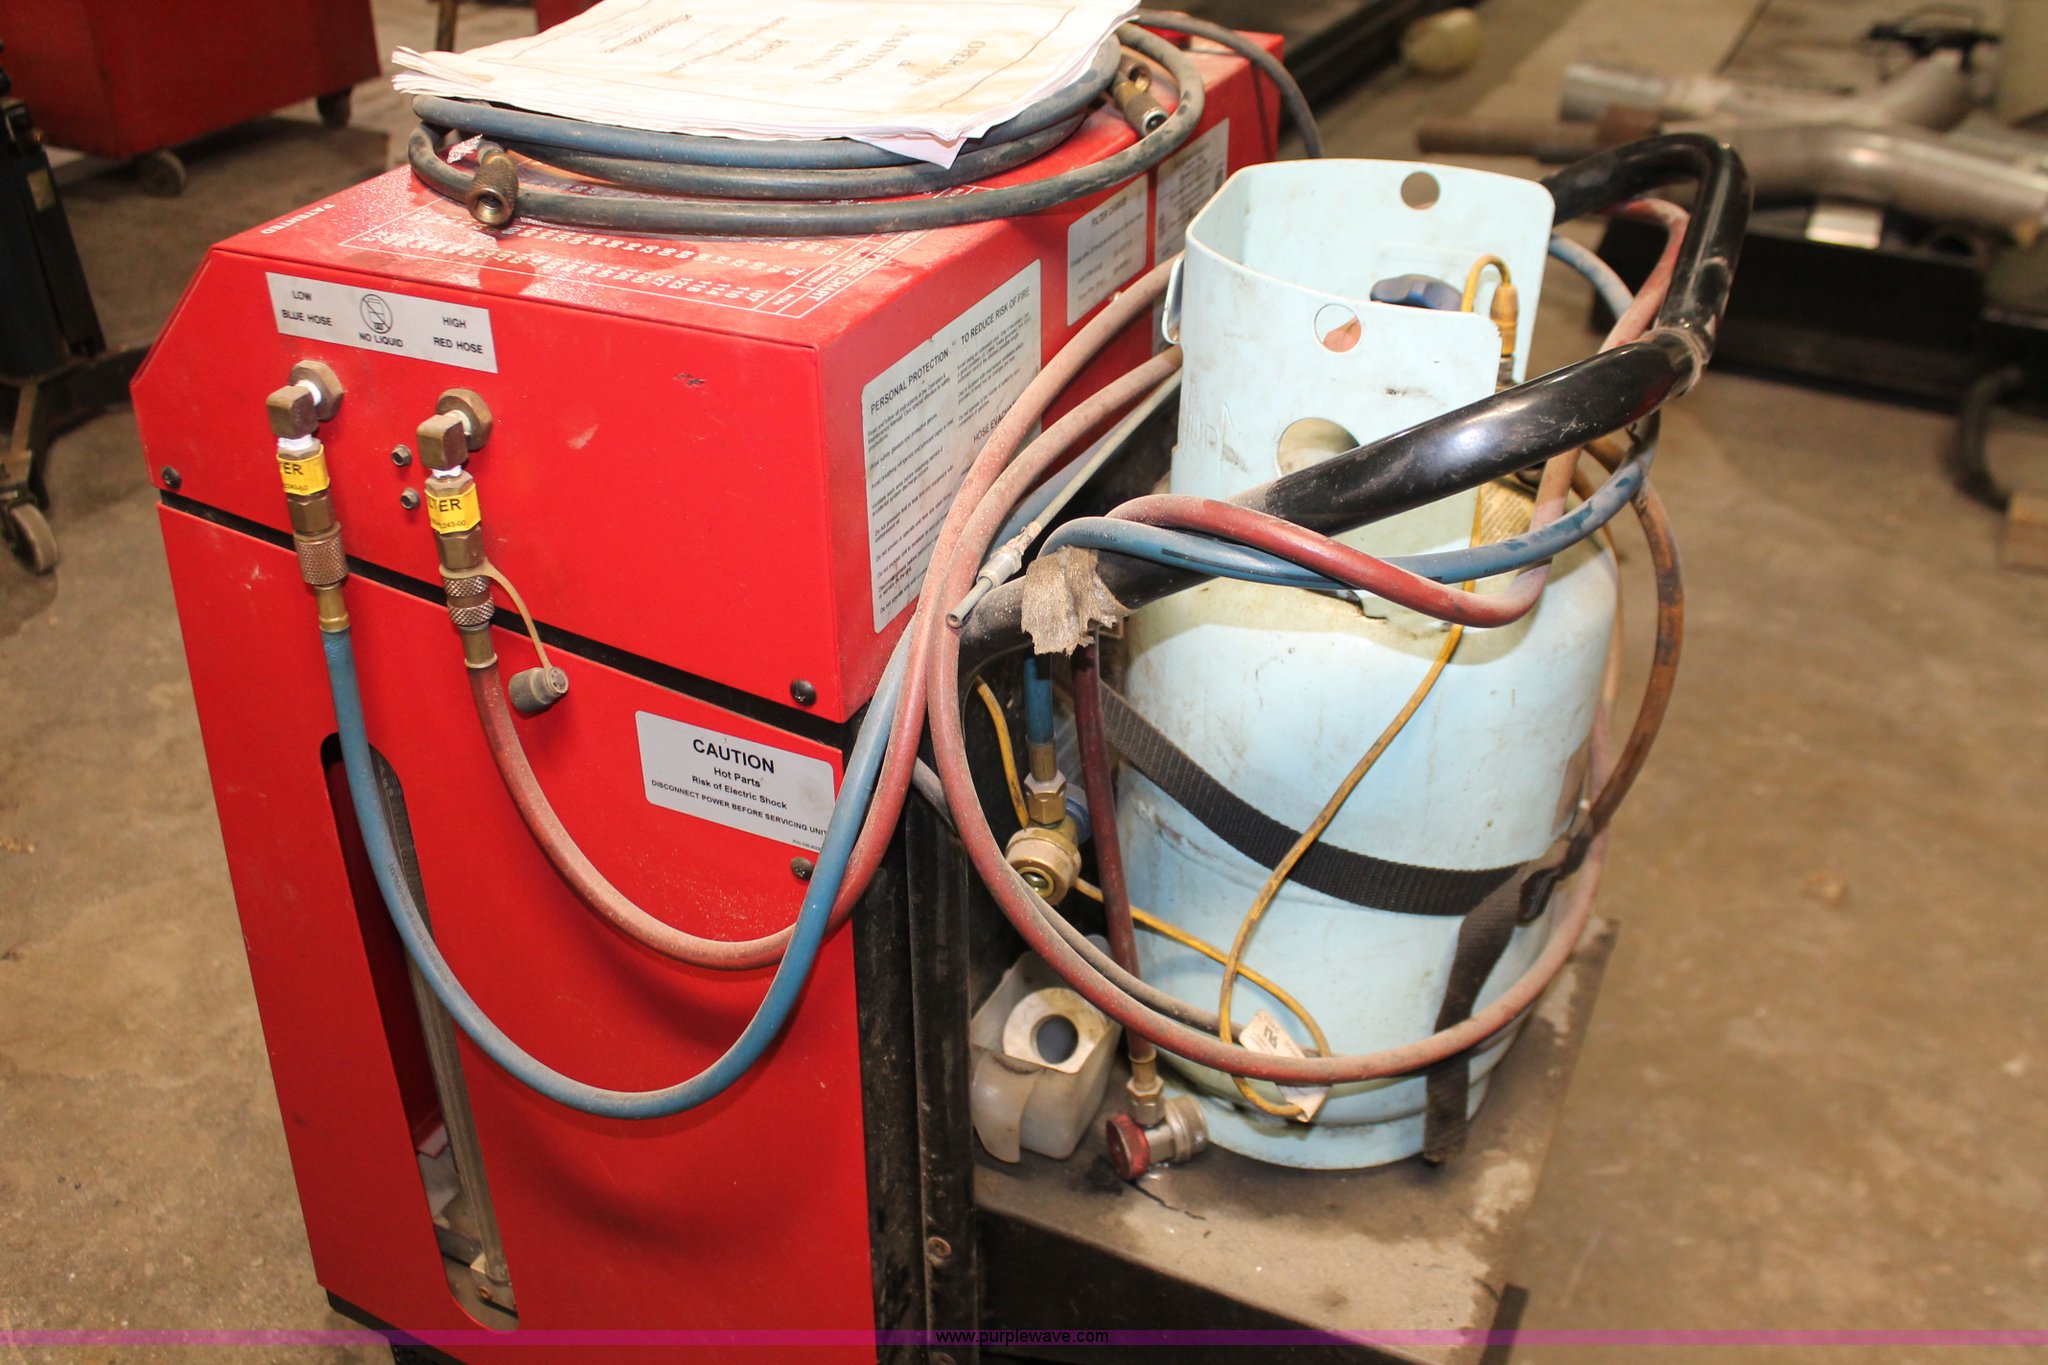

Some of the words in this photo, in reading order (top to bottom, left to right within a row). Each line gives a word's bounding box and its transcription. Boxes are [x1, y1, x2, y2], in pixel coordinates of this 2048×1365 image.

[260, 203, 336, 234] PATENTED
[844, 254, 886, 277] PURGE
[651, 275, 674, 286] 127
[808, 276, 850, 300] CHART
[292, 290, 312, 302] LOW
[745, 290, 770, 301] 107
[282, 309, 304, 322] BLUE
[308, 312, 333, 326] HOSE
[442, 316, 466, 329] HIGH
[961, 331, 969, 345] TO
[970, 312, 993, 338] REDUCE
[995, 301, 1008, 319] RISK
[1009, 295, 1016, 309] OF
[1017, 285, 1029, 303] FIRE
[359, 332, 371, 342] NO
[375, 334, 403, 348] LIQUID
[433, 337, 452, 348] RED
[456, 342, 483, 354] HOSE
[870, 378, 906, 415] PERSONAL
[908, 346, 948, 386] PROTECTION
[973, 422, 988, 443] HOSE
[692, 738, 775, 774] CAUTION
[714, 766, 731, 780] Hot
[734, 772, 761, 788] Parts
[692, 775, 711, 787] Risk
[724, 784, 757, 801] Electric
[759, 795, 787, 810] Shock
[651, 779, 699, 799] DISCONNECT
[701, 794, 730, 808] POWER
[732, 803, 763, 818] BEFORE
[765, 813, 808, 831] SERVICING
